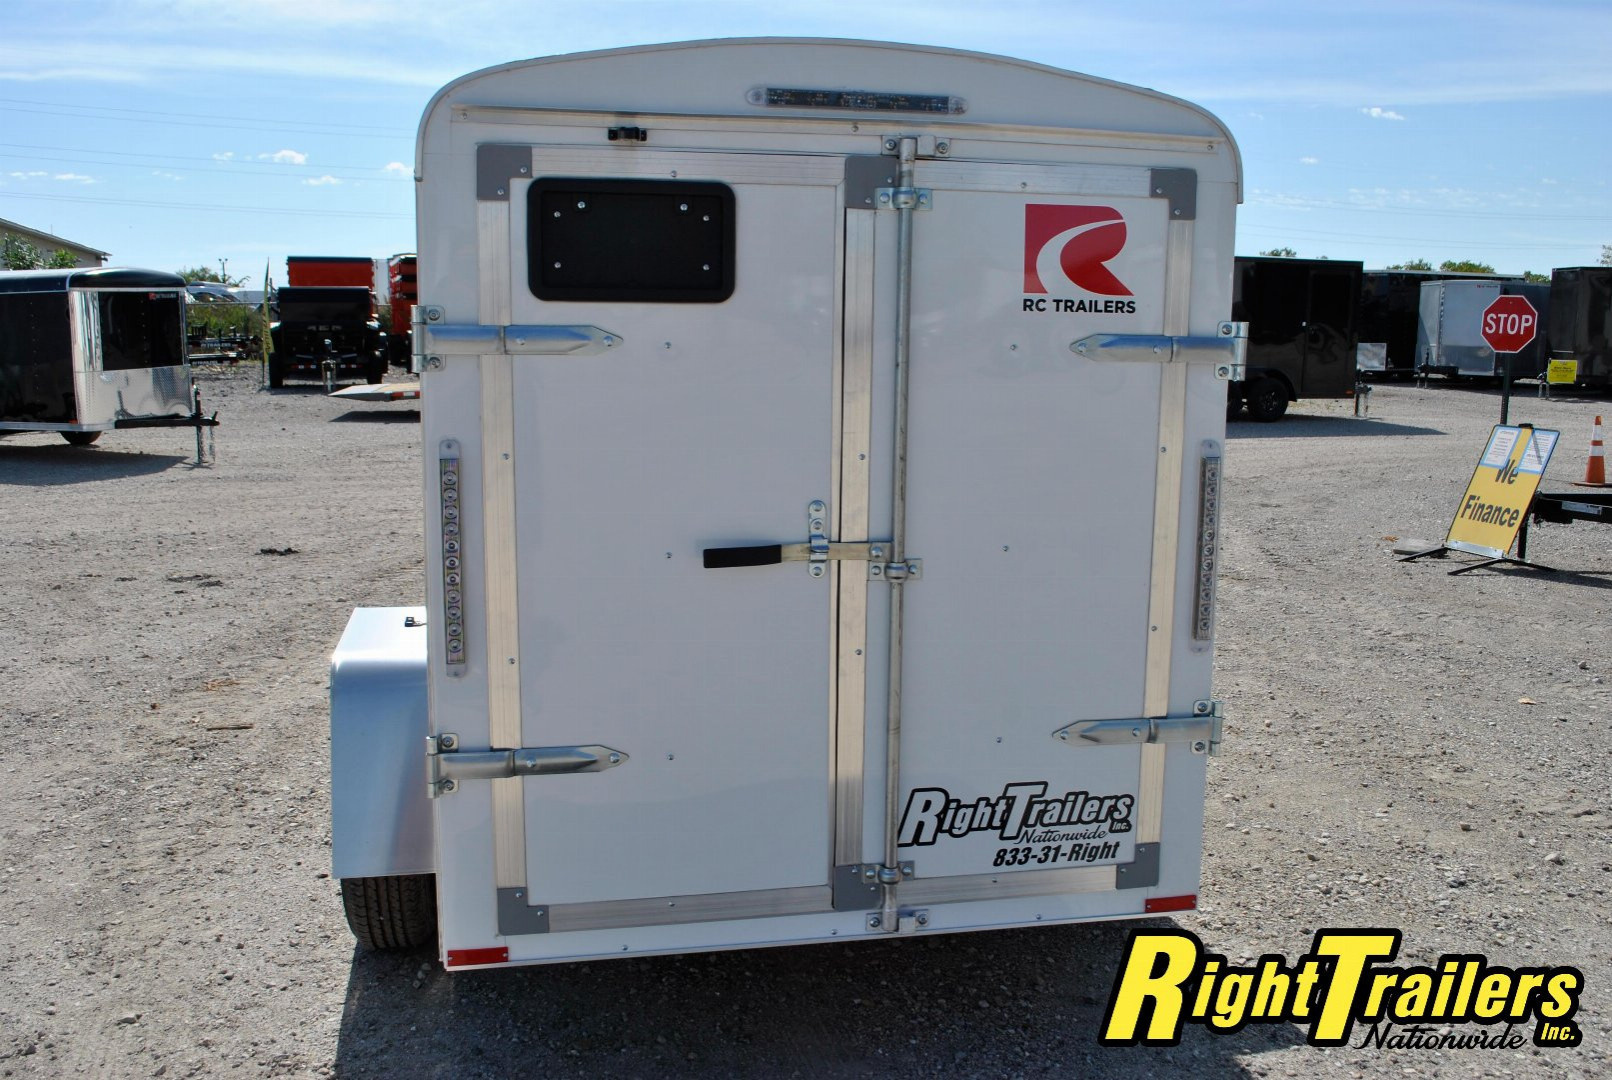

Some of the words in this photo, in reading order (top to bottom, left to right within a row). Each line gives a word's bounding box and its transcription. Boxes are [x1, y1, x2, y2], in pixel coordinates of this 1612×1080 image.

[1023, 298, 1046, 312] RC
[1052, 299, 1136, 314] TRAILERS
[1485, 313, 1533, 335] STOP
[1495, 459, 1519, 485] We
[1460, 494, 1520, 528] Finance
[1014, 826, 1109, 845] Nationwide
[1110, 820, 1131, 833] Inc.
[992, 841, 1121, 867] 833-31-Right
